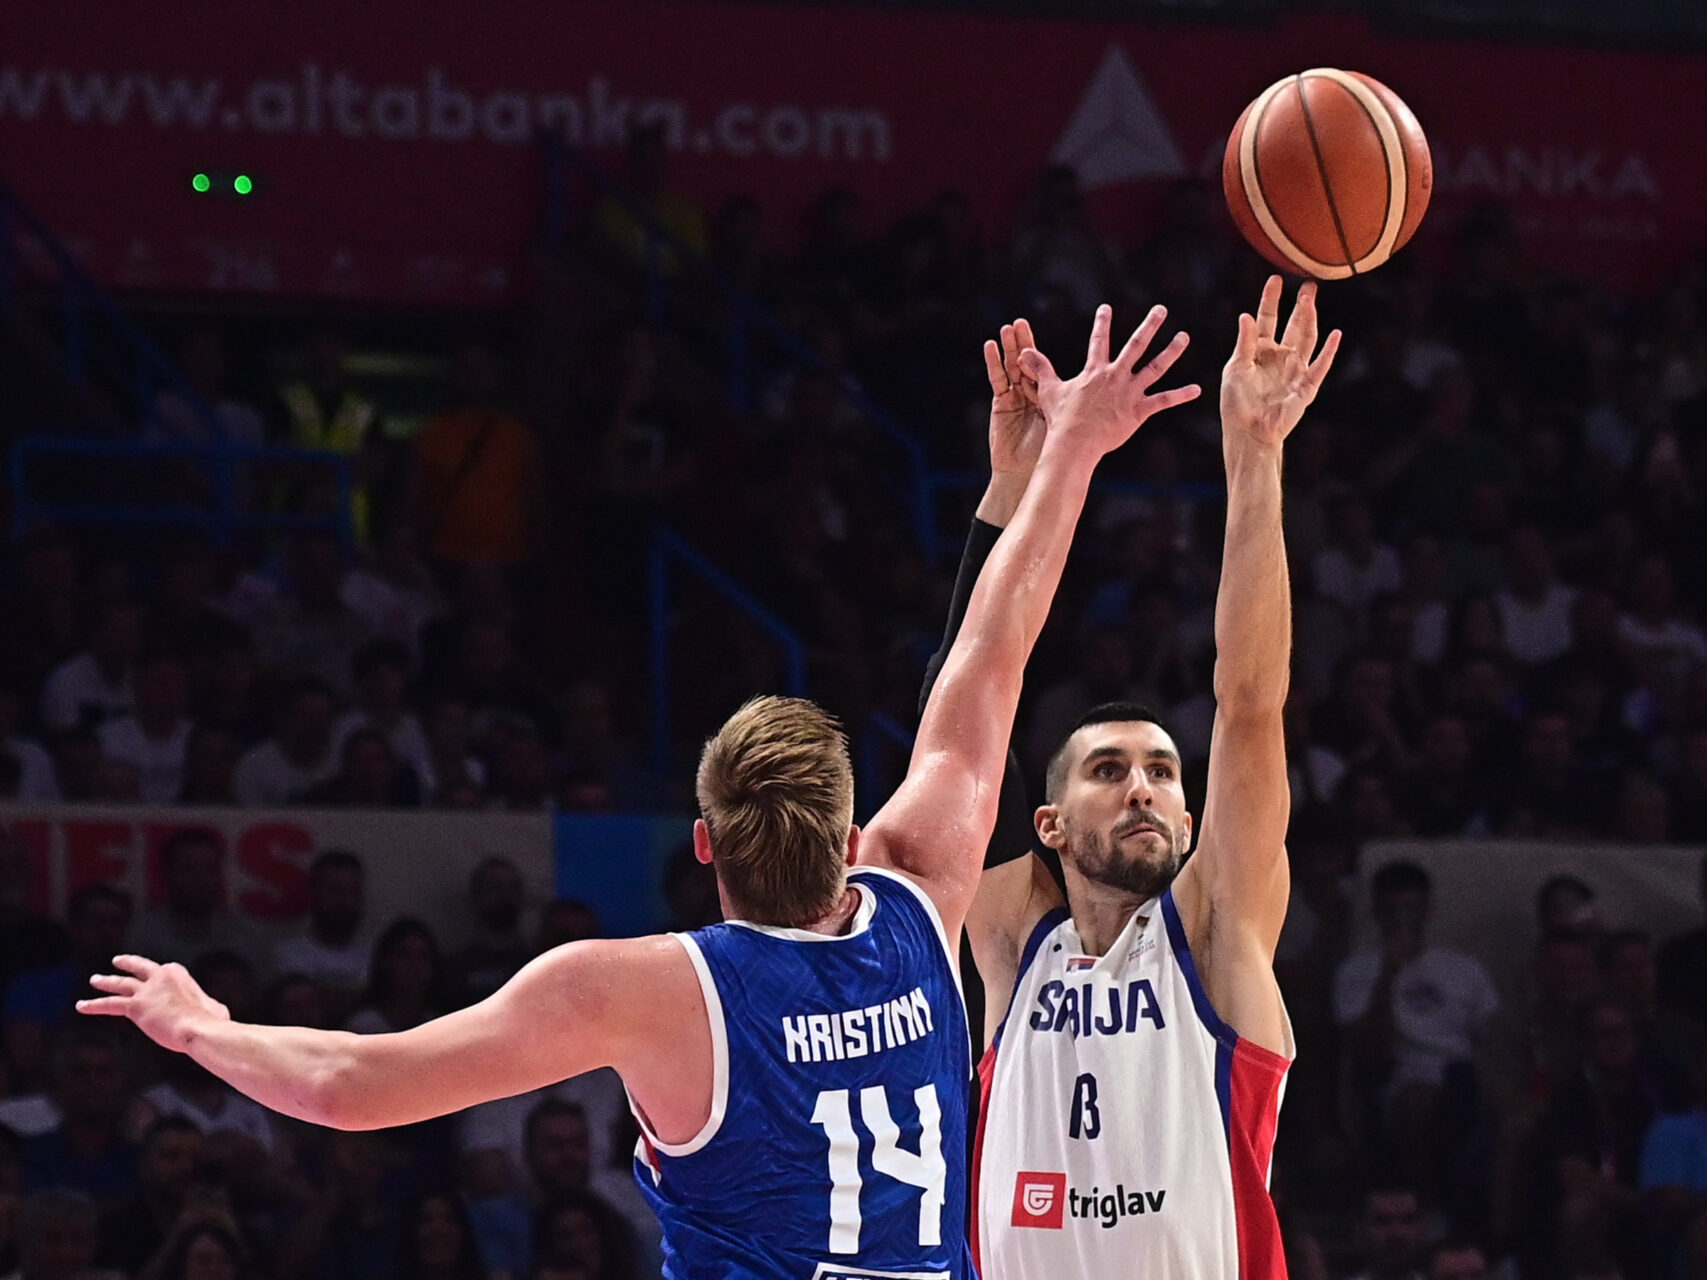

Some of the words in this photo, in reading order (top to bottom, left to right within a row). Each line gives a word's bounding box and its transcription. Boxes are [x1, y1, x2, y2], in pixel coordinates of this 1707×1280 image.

[781, 986, 934, 1063] KRISTINN
[809, 1083, 947, 1254] 14
[1068, 1184, 1167, 1229] triglav
